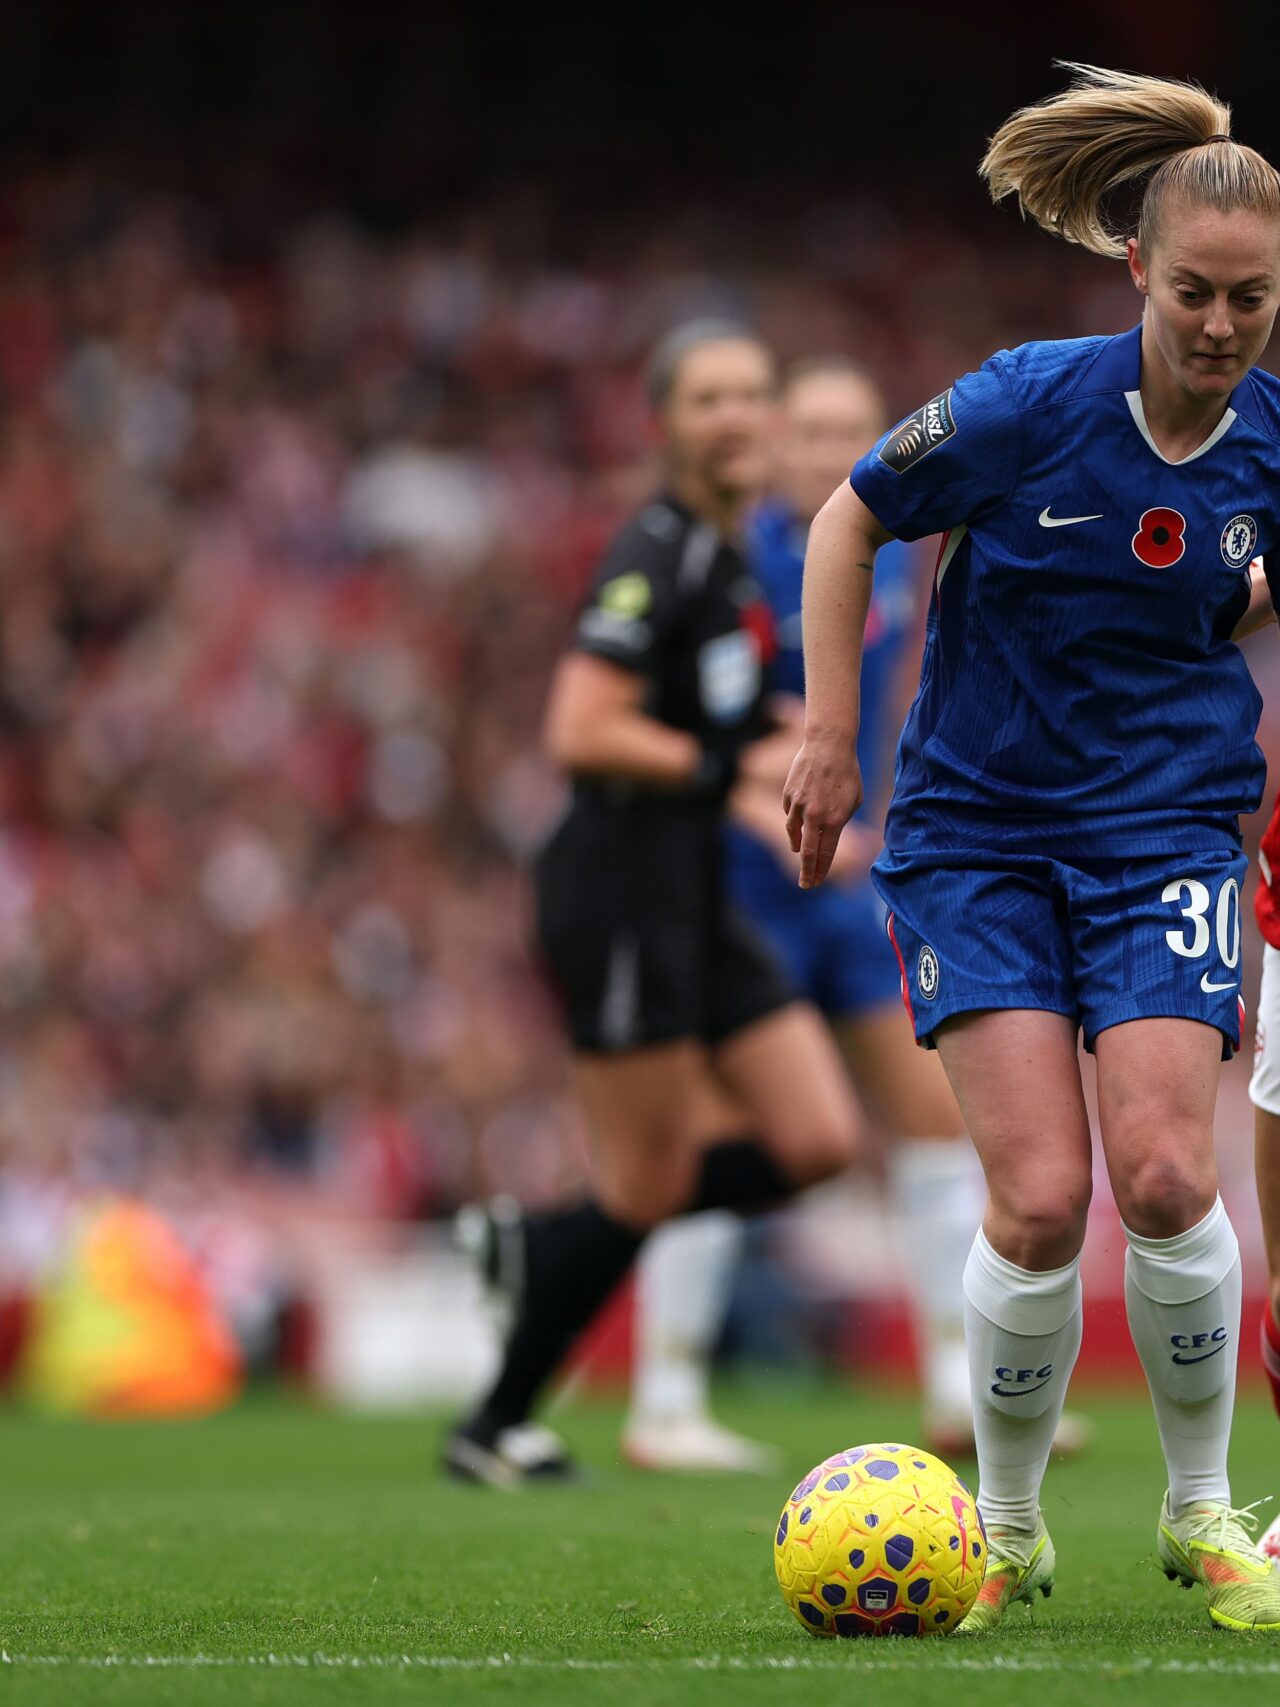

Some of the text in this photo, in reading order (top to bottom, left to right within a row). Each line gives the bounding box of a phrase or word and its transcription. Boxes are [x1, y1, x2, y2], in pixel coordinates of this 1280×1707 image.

[927, 402, 944, 441] WSL
[1230, 517, 1254, 528] CHELSEA
[1161, 877, 1240, 969] 30
[1171, 1327, 1227, 1349] CFC
[995, 1364, 1053, 1383] CFC
